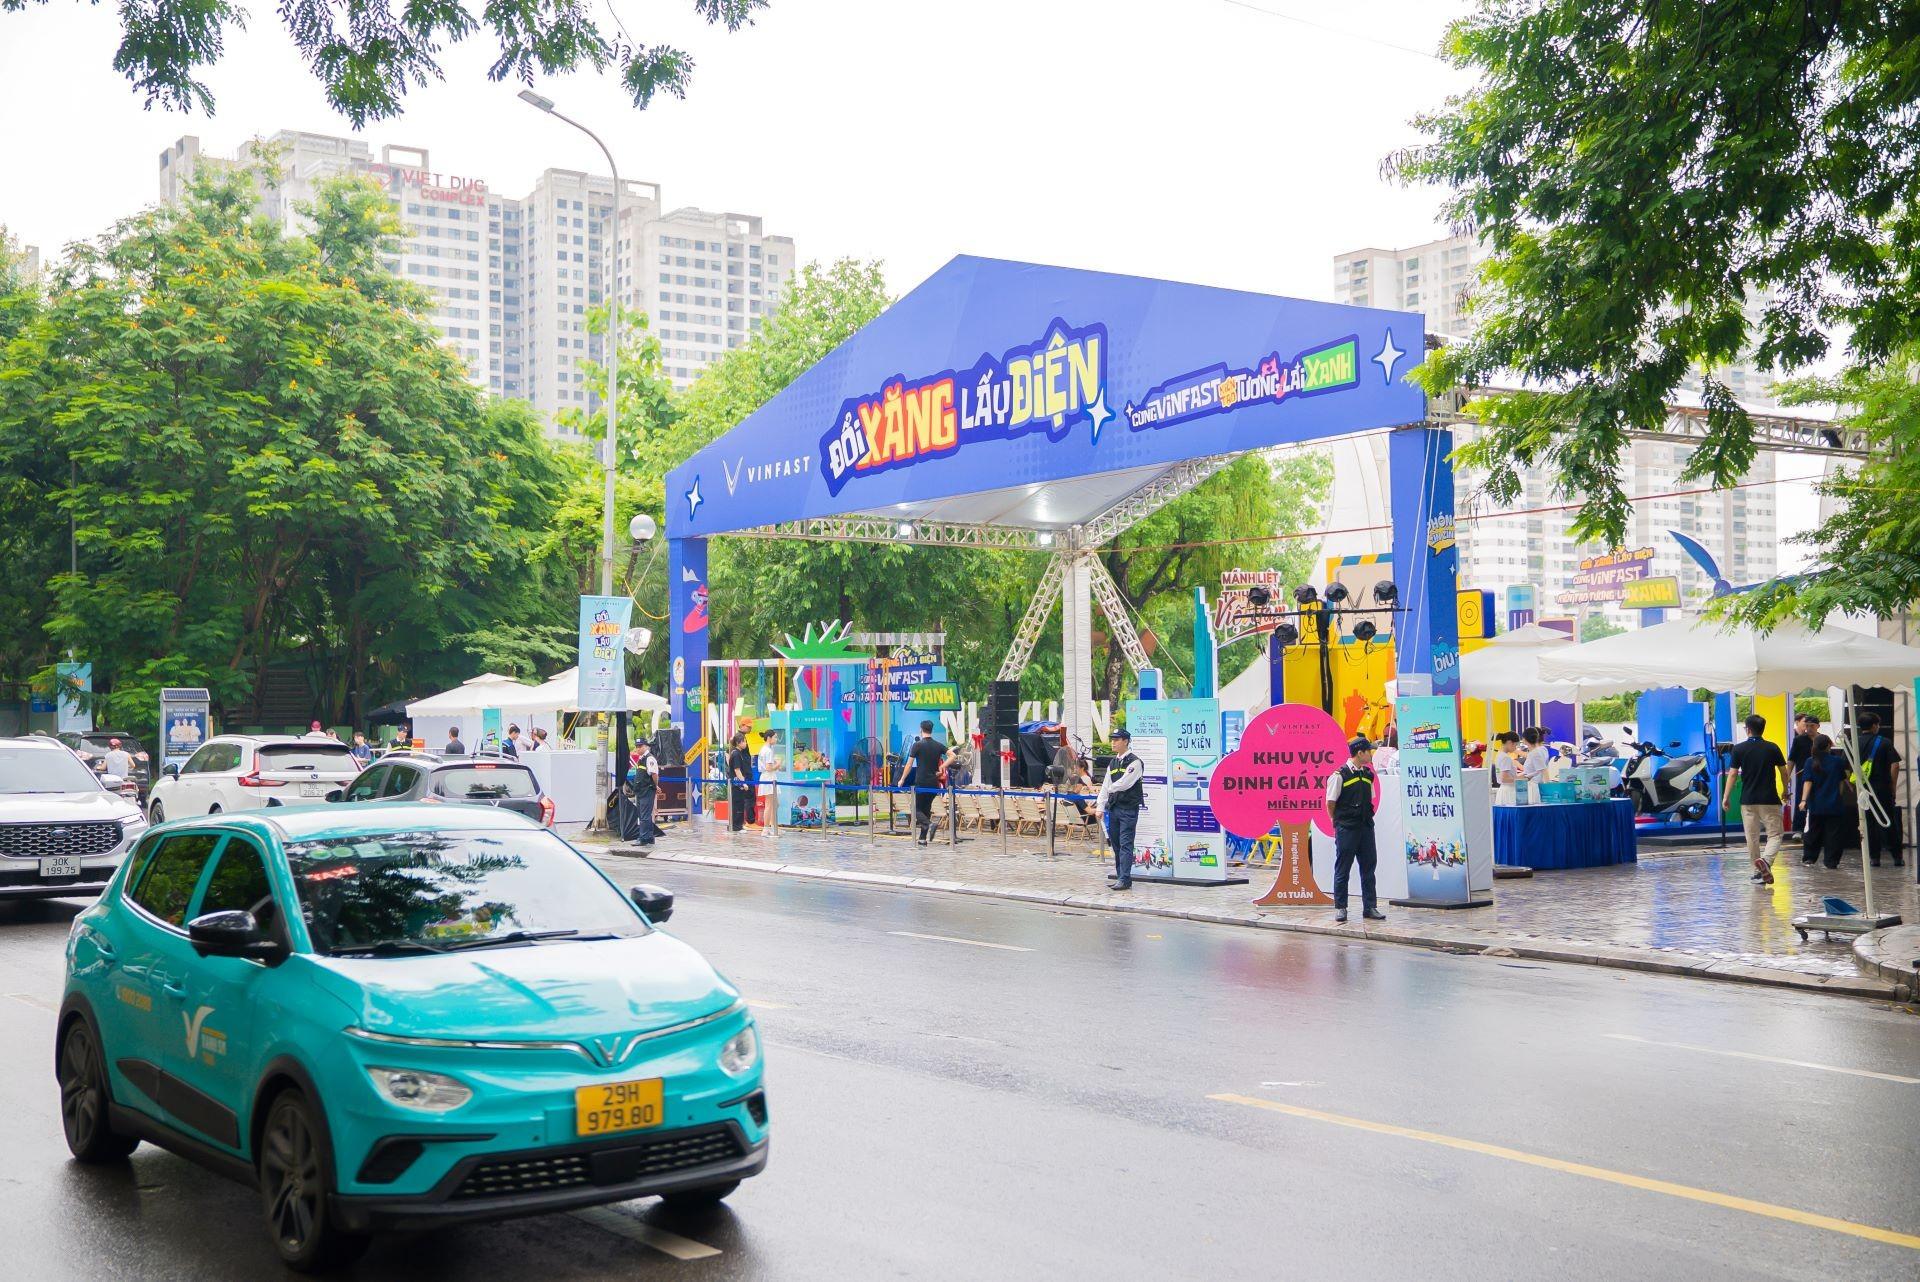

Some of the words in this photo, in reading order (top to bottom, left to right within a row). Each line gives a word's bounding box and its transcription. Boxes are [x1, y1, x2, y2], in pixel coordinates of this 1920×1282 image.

[421, 187, 485, 207] COMPLEX
[1303, 351, 1352, 388] XANH
[859, 379, 956, 466] XĂNG
[747, 455, 810, 483] VINFAST
[1629, 583, 1673, 602] XANH
[861, 633, 947, 646] VINFAST
[914, 687, 954, 705] XANH
[1253, 752, 1294, 765] KHU
[1298, 749, 1335, 768] VỰC
[1223, 776, 1273, 795] ĐỊNH
[1277, 769, 1309, 790] GIÁ
[1408, 766, 1427, 778] KHU
[1431, 764, 1451, 781] VỰC
[1427, 784, 1455, 798] XĂNG
[1267, 795, 1298, 809] MIỄN
[1300, 796, 1322, 809] PHÍ
[46, 866, 76, 875] 199.75
[52, 857, 69, 866] 30K
[1276, 891, 1288, 899] 01
[1288, 886, 1314, 899] TUẦN
[603, 1083, 639, 1106] 29H
[587, 1104, 654, 1131] 979.80
